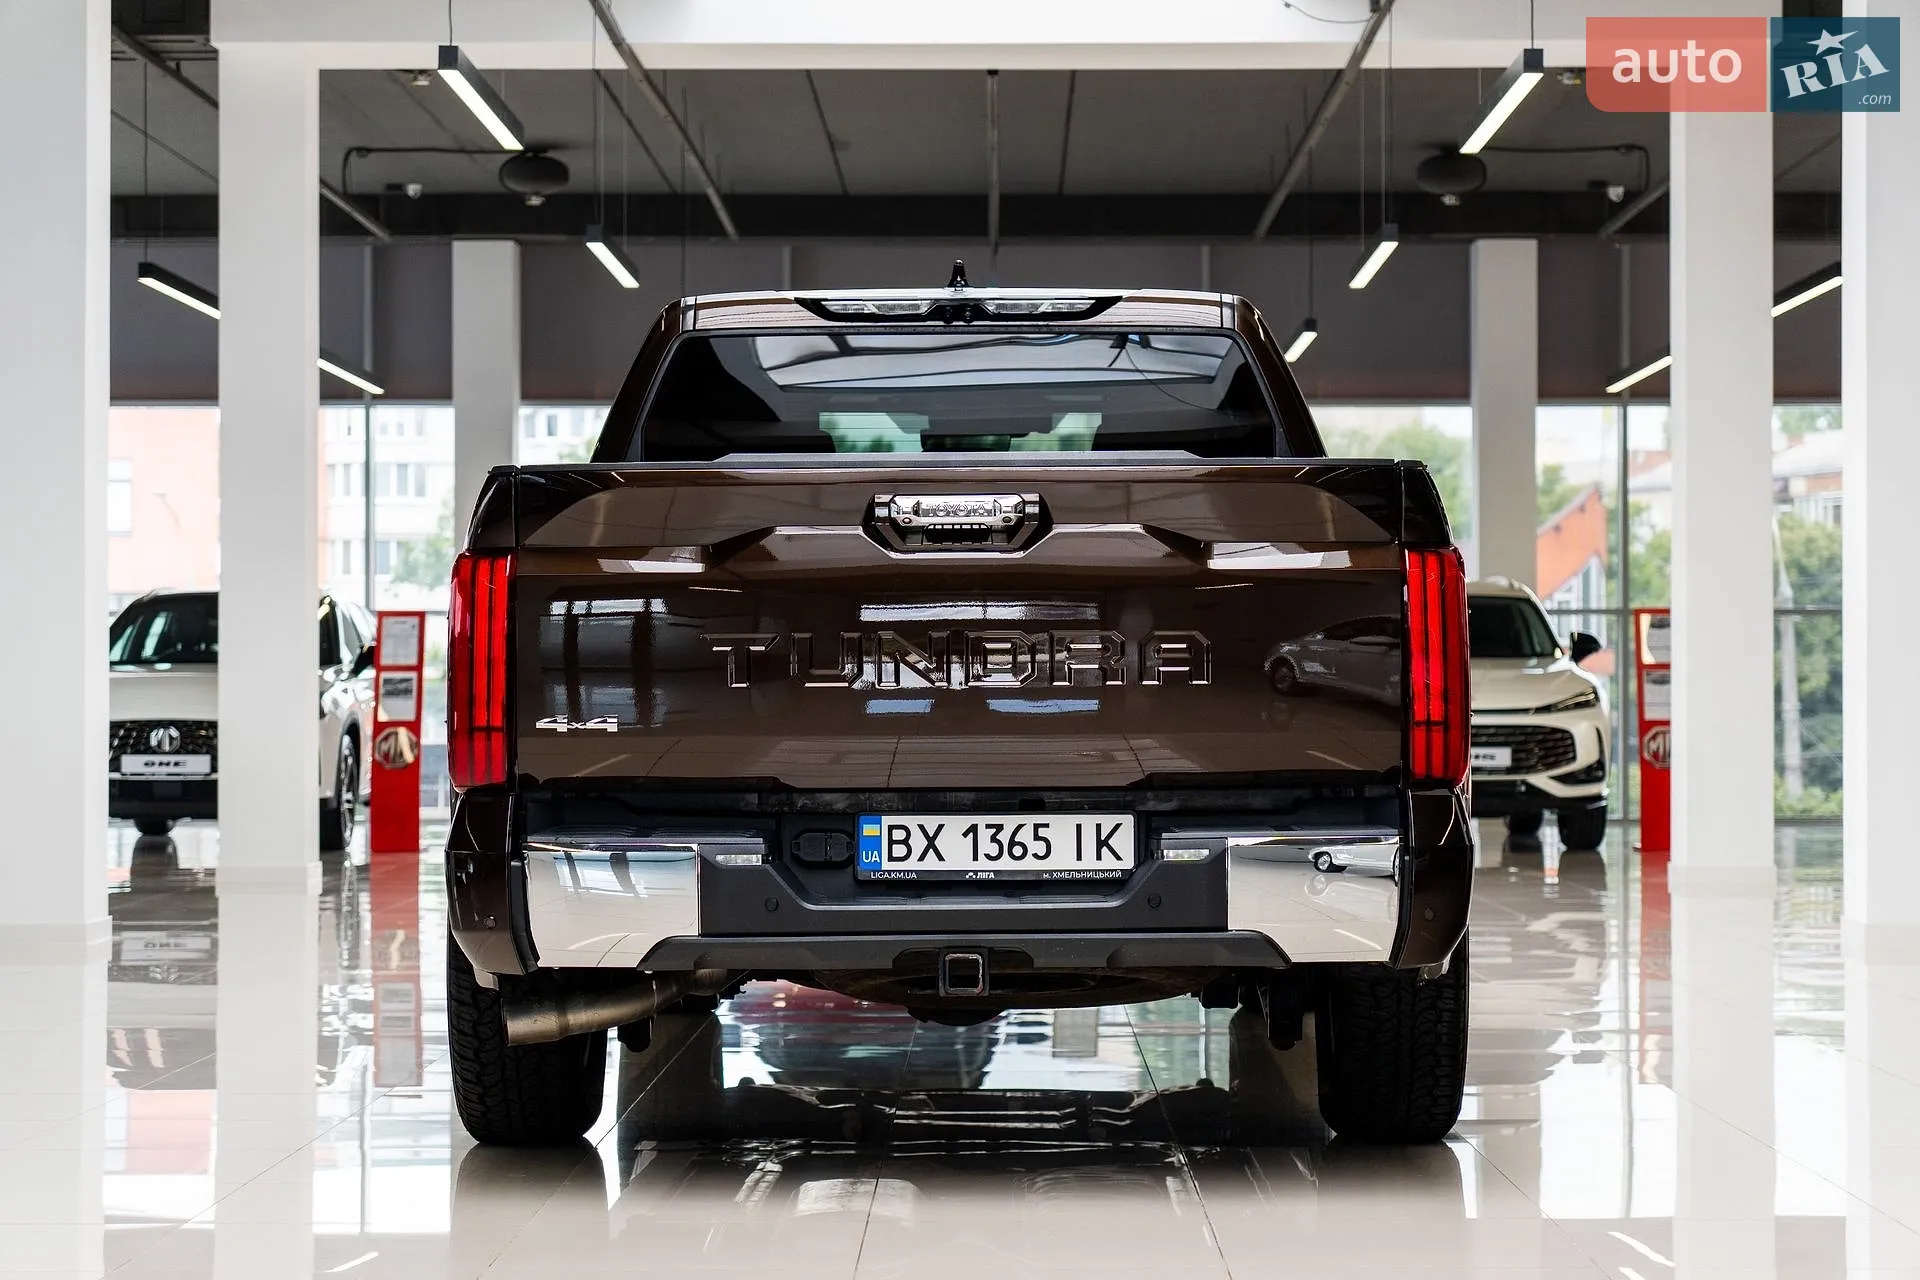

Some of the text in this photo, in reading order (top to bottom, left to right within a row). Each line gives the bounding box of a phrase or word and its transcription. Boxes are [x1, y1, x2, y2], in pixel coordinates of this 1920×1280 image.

[926, 503, 988, 516] TOYOTA
[699, 629, 1212, 689] TUNDRA
[143, 760, 187, 768] ONE
[887, 822, 1124, 863] BX 1365 IK
[862, 850, 880, 863] UA
[870, 871, 917, 879] LIGA.KM.UA
[976, 871, 995, 879] ЛІГА
[1052, 869, 1122, 879] ХМЕЛЬНИЦЬКИЙ
